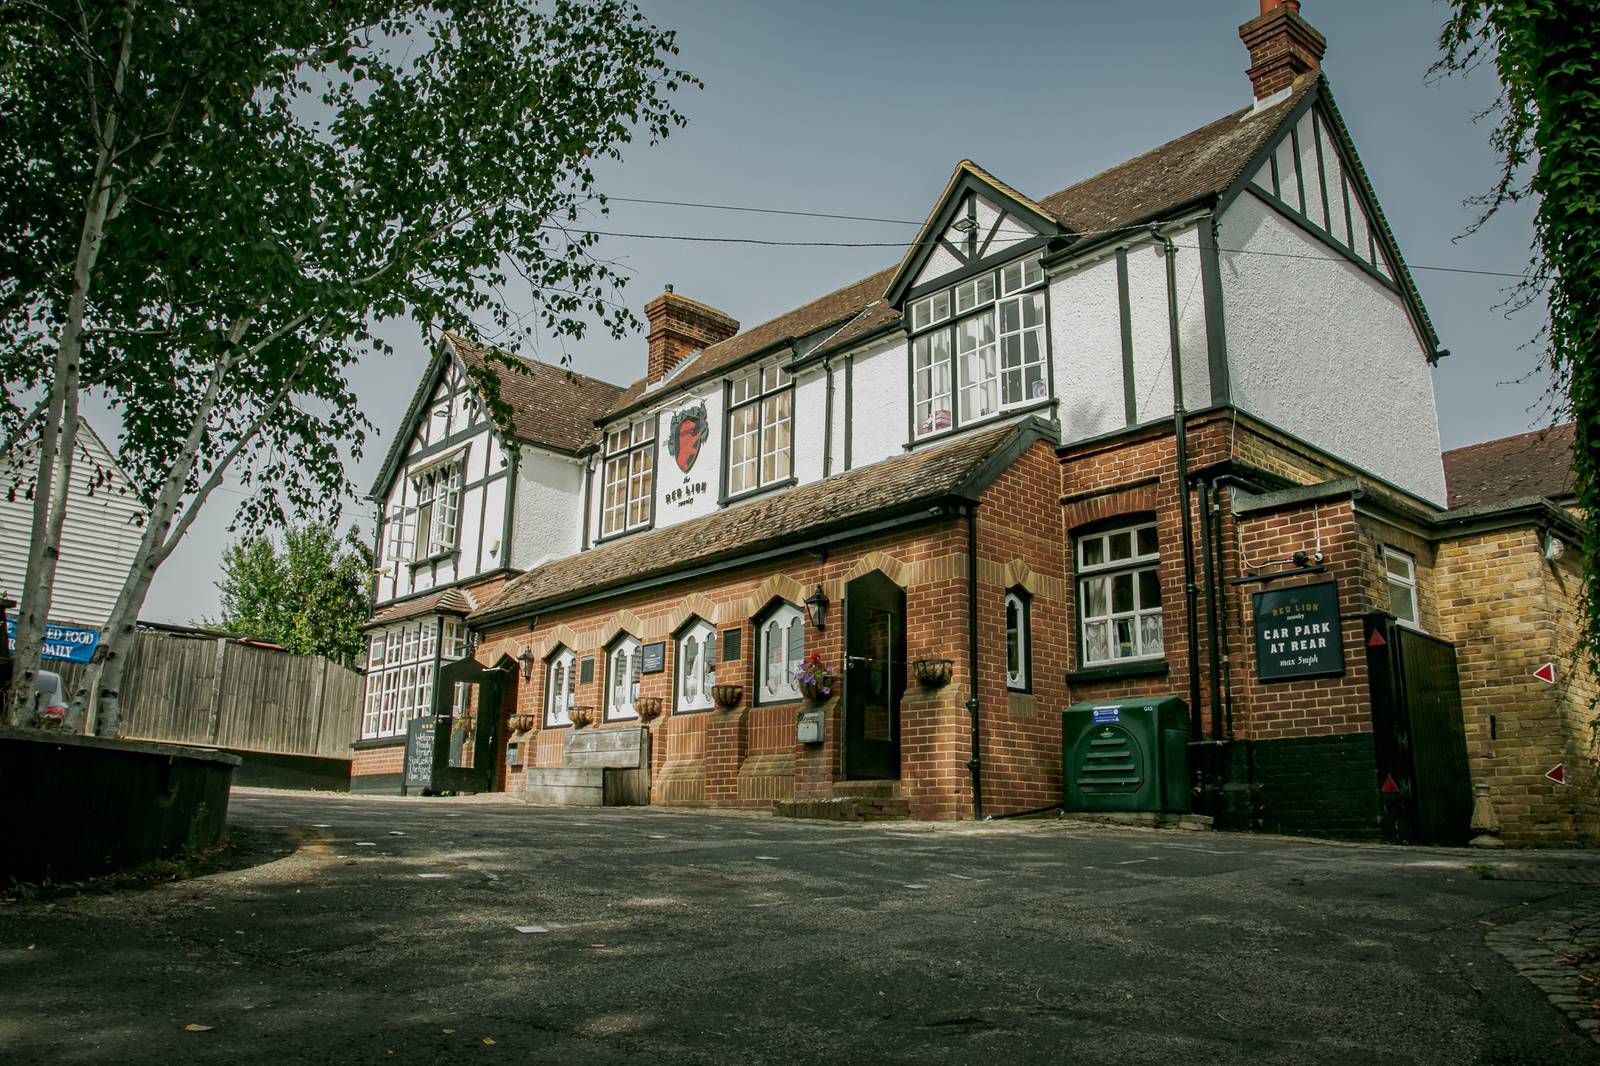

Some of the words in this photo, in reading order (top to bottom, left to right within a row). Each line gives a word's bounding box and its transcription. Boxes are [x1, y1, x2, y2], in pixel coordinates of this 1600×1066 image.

[665, 488, 682, 505] RED
[686, 481, 707, 496] LION
[1272, 606, 1291, 616] RED
[1295, 603, 1319, 612] LION
[64, 630, 94, 645] FOOD
[1263, 628, 1289, 640] CAR
[1294, 622, 1330, 636] PARK
[42, 644, 74, 658] DAILY
[1270, 642, 1285, 654] AT
[1291, 638, 1327, 651] REAR
[1280, 659, 1296, 667] max
[1297, 654, 1318, 667] 5mph
